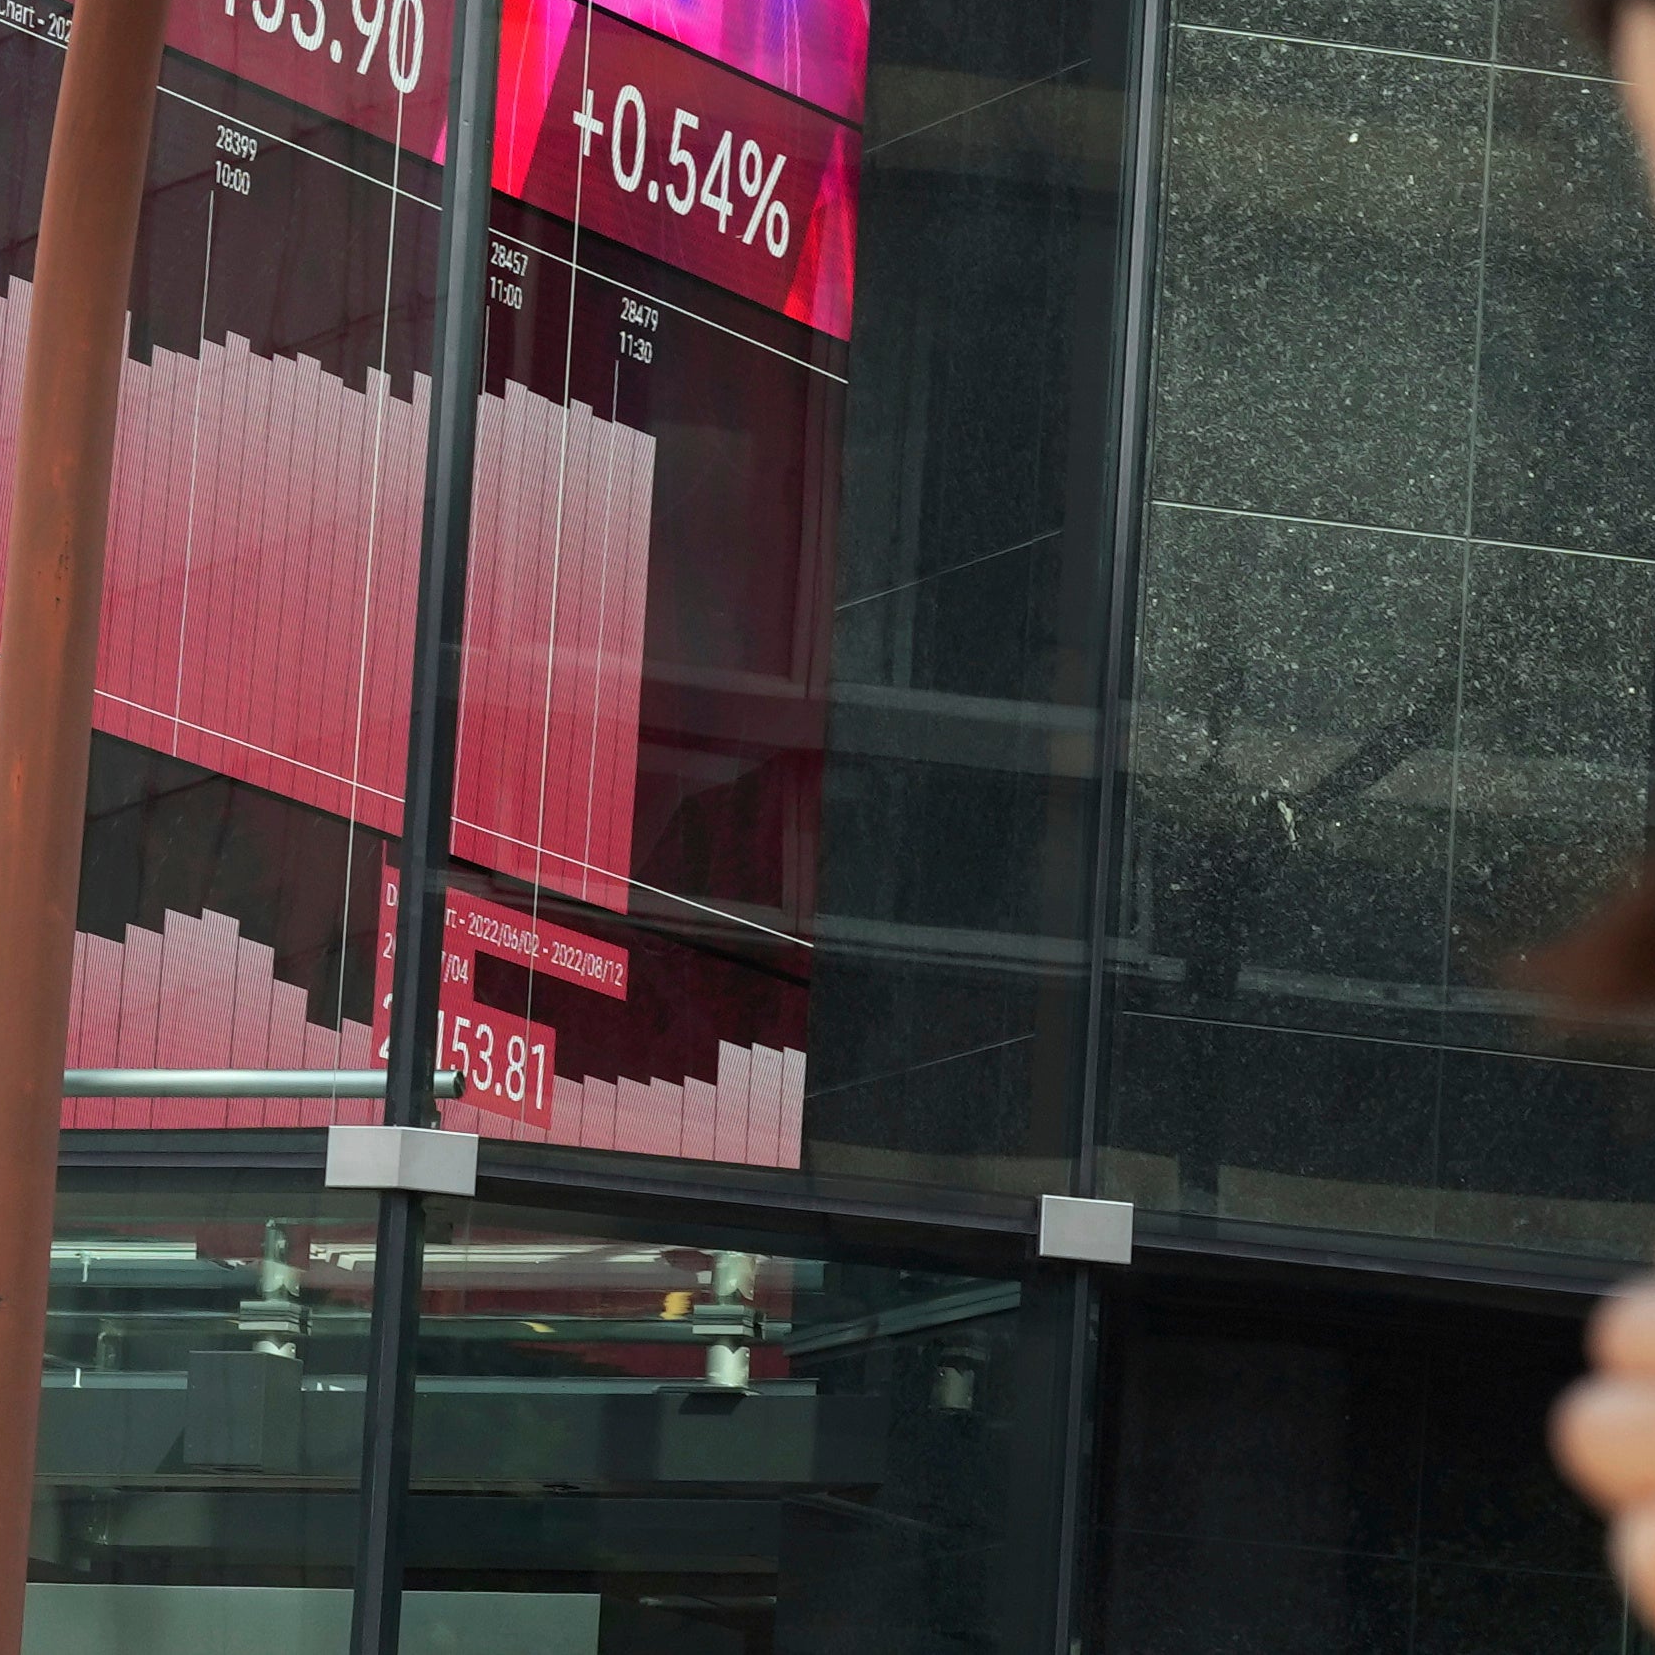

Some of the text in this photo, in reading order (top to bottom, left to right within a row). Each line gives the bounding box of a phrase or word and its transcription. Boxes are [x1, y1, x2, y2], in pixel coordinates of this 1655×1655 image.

[215, 124, 258, 162] 28399
[214, 160, 251, 196] 10:00
[572, 84, 790, 259] +0.54%
[489, 241, 530, 277] 28457
[489, 276, 524, 310] 11:00
[620, 296, 660, 333] 28479
[618, 330, 653, 364] 11:30
[467, 911, 541, 958] 2022/06/02
[550, 940, 624, 987] 2022/08/12
